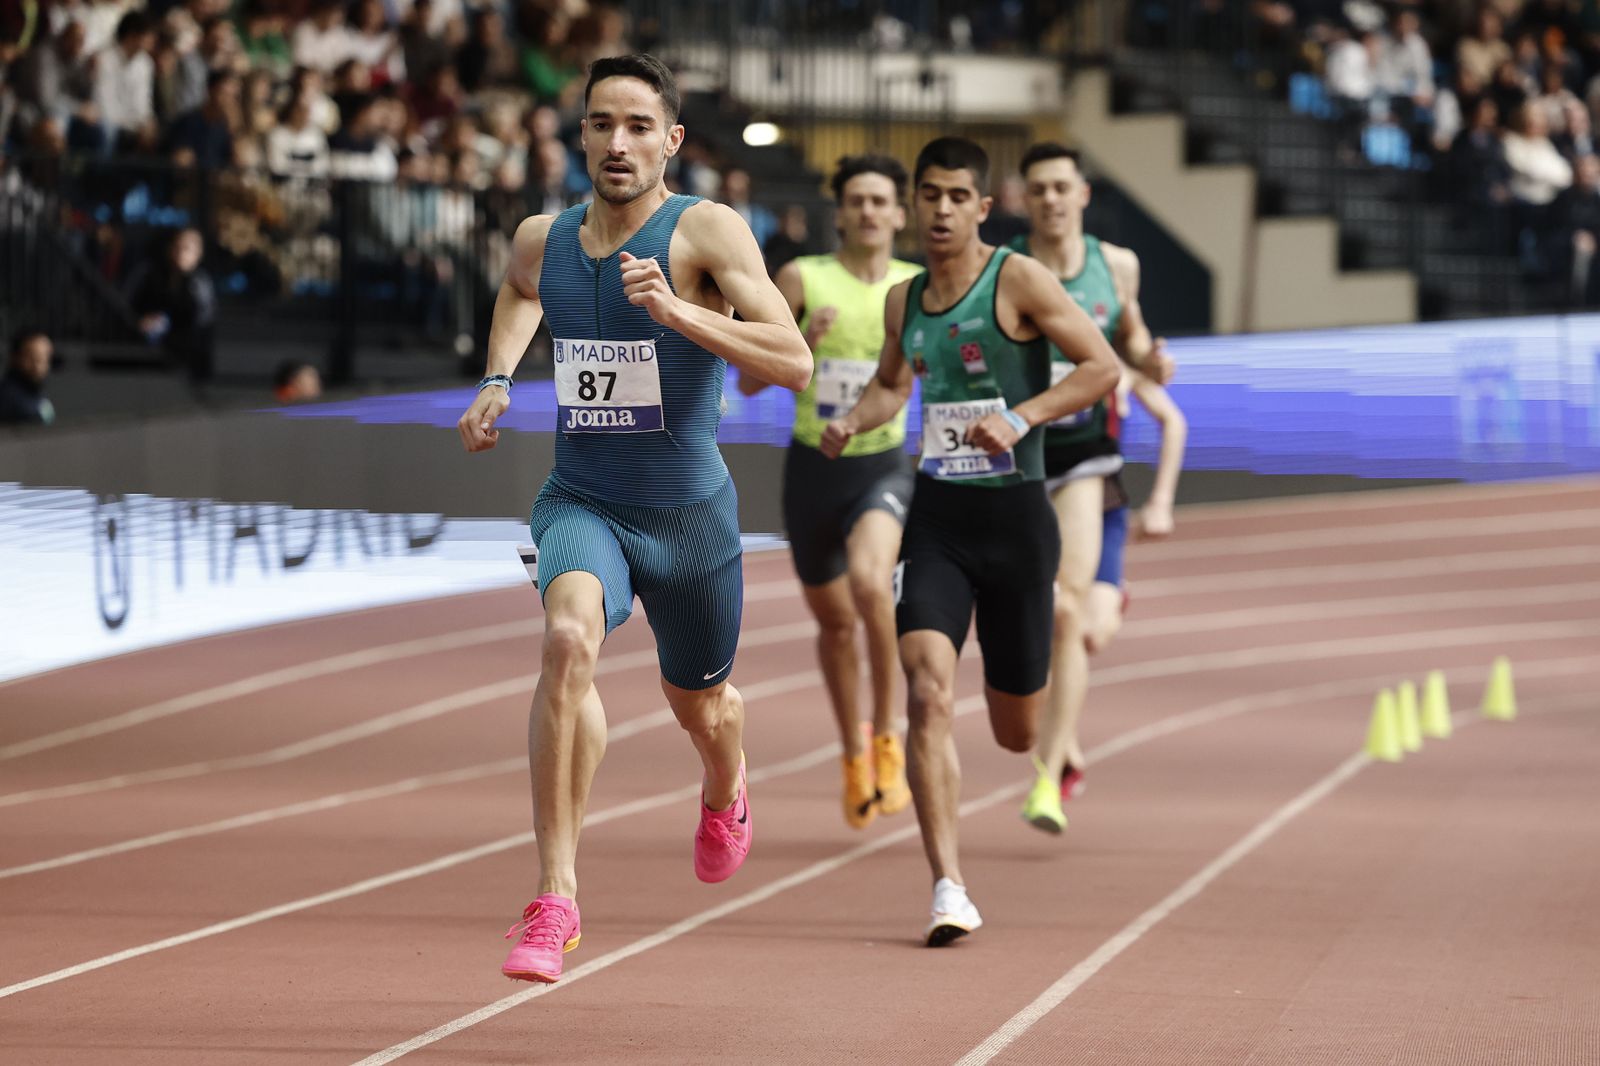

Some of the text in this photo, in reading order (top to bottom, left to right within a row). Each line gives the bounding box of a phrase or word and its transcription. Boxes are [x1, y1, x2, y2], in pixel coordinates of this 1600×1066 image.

[572, 344, 654, 363] MADRID
[578, 370, 617, 401] 87
[944, 427, 976, 452] 34
